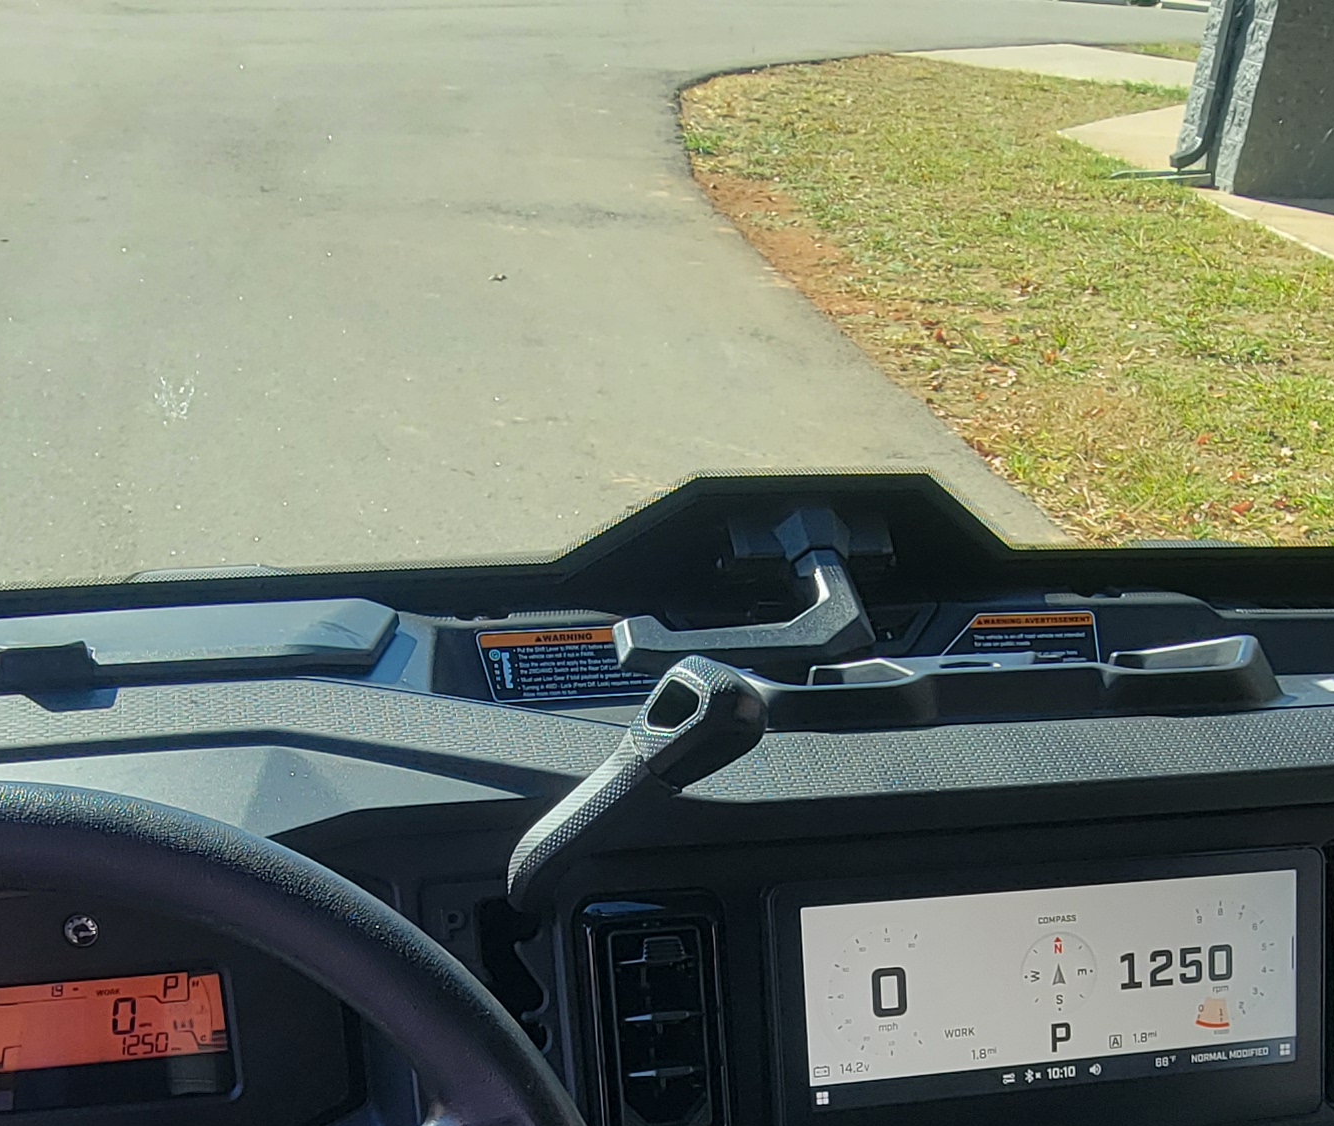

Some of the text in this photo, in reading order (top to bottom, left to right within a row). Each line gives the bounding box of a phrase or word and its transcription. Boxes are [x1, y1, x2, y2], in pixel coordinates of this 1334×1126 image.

[1025, 616, 1091, 624] AVERTISSEMENT
[542, 632, 593, 642] WARNING
[1037, 914, 1077, 925] COMPASS
[1054, 943, 1063, 954] N
[1119, 943, 1233, 991] 1250
[95, 989, 121, 997] WORK
[164, 976, 178, 999] P
[871, 966, 908, 1018] 0
[1212, 984, 1230, 994] rpm
[1055, 994, 1064, 1006] S
[112, 997, 136, 1036] 0
[878, 1022, 899, 1035] mph
[943, 1027, 976, 1039] WORK
[122, 1032, 169, 1056] 1250
[1051, 1022, 1072, 1053] P
[1191, 1050, 1228, 1064] NORMAL
[1229, 1046, 1270, 1061] MODIFIED
[1046, 1065, 1077, 1081] 10:10
